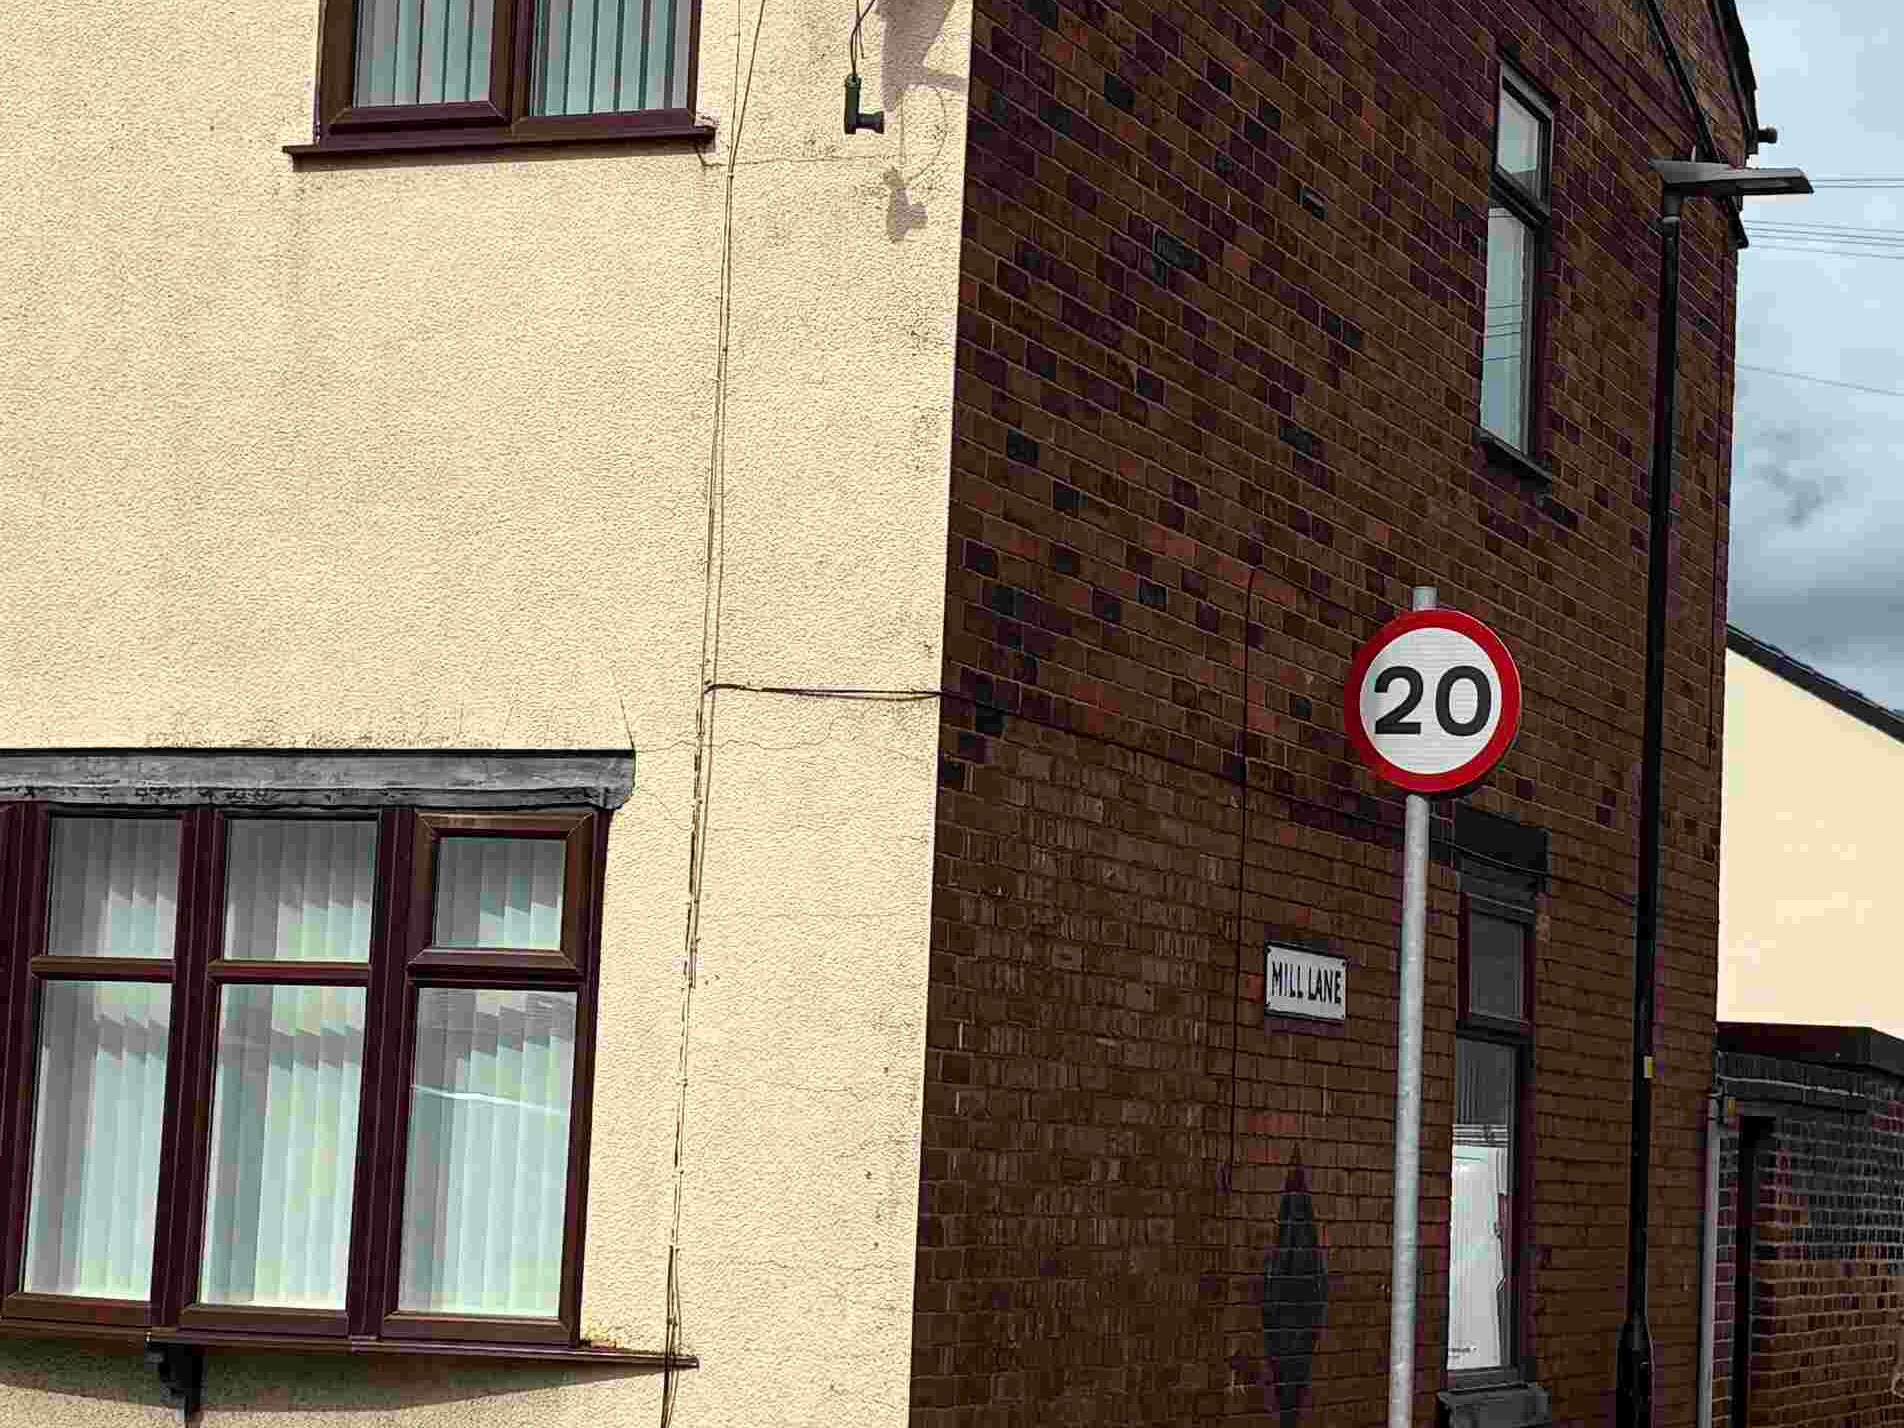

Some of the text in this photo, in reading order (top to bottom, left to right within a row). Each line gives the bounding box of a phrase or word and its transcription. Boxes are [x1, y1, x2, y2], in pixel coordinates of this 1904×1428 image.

[1372, 665, 1493, 736] 20
[1271, 961, 1342, 1004] MILL LANE
